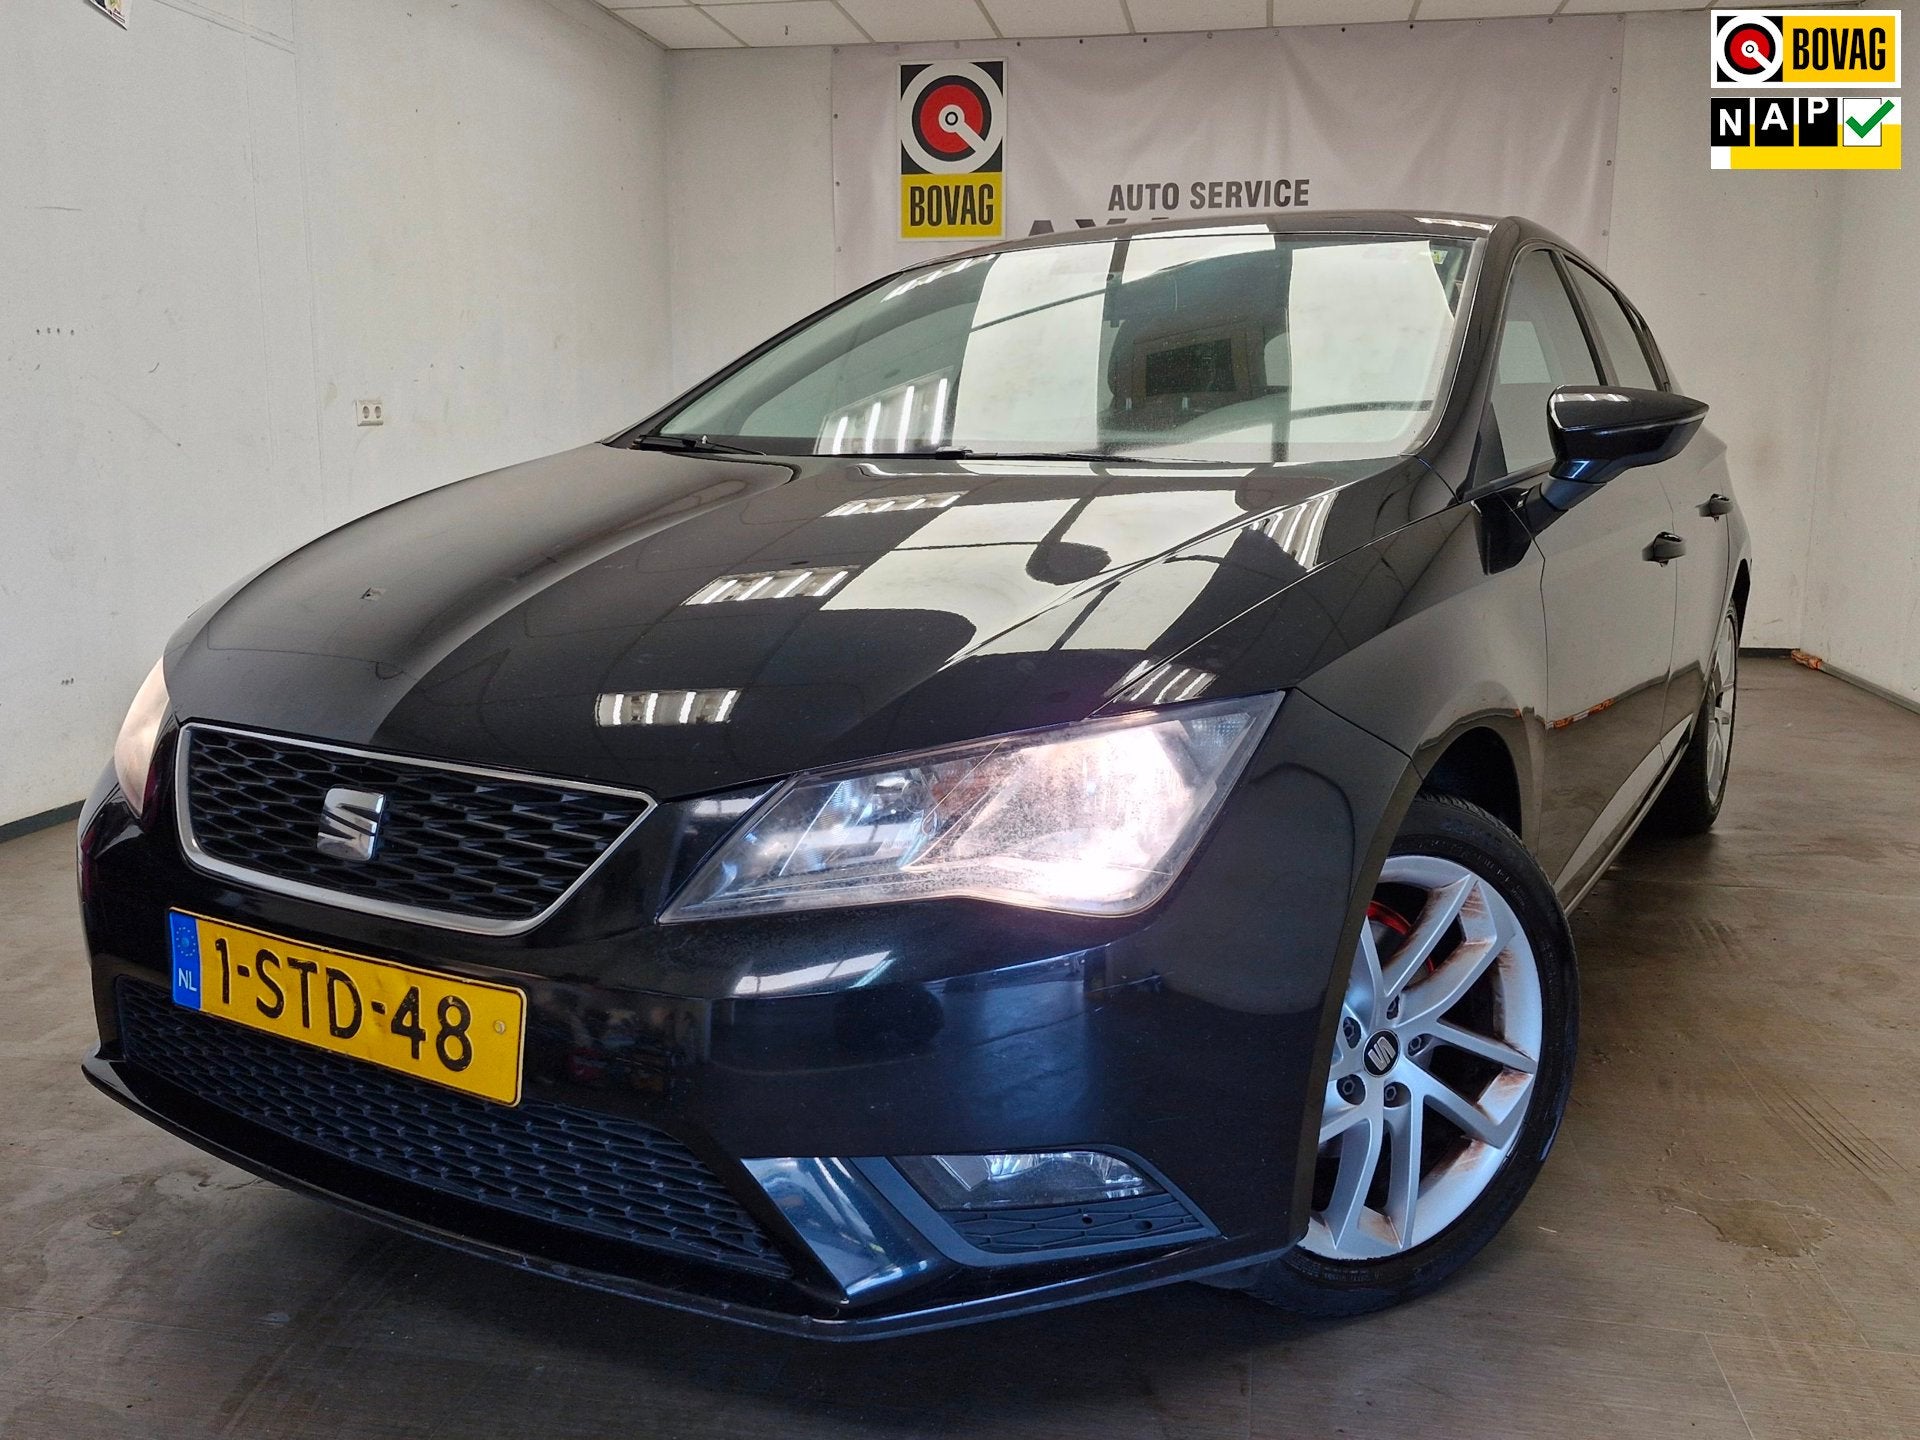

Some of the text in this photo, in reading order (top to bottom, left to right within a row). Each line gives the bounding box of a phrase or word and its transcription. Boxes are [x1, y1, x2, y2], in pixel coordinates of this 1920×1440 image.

[909, 183, 994, 228] BOVAG
[1108, 179, 1311, 212] AUTO SERVICE
[178, 967, 198, 992] NL
[215, 937, 474, 1072] 1-STD-48
